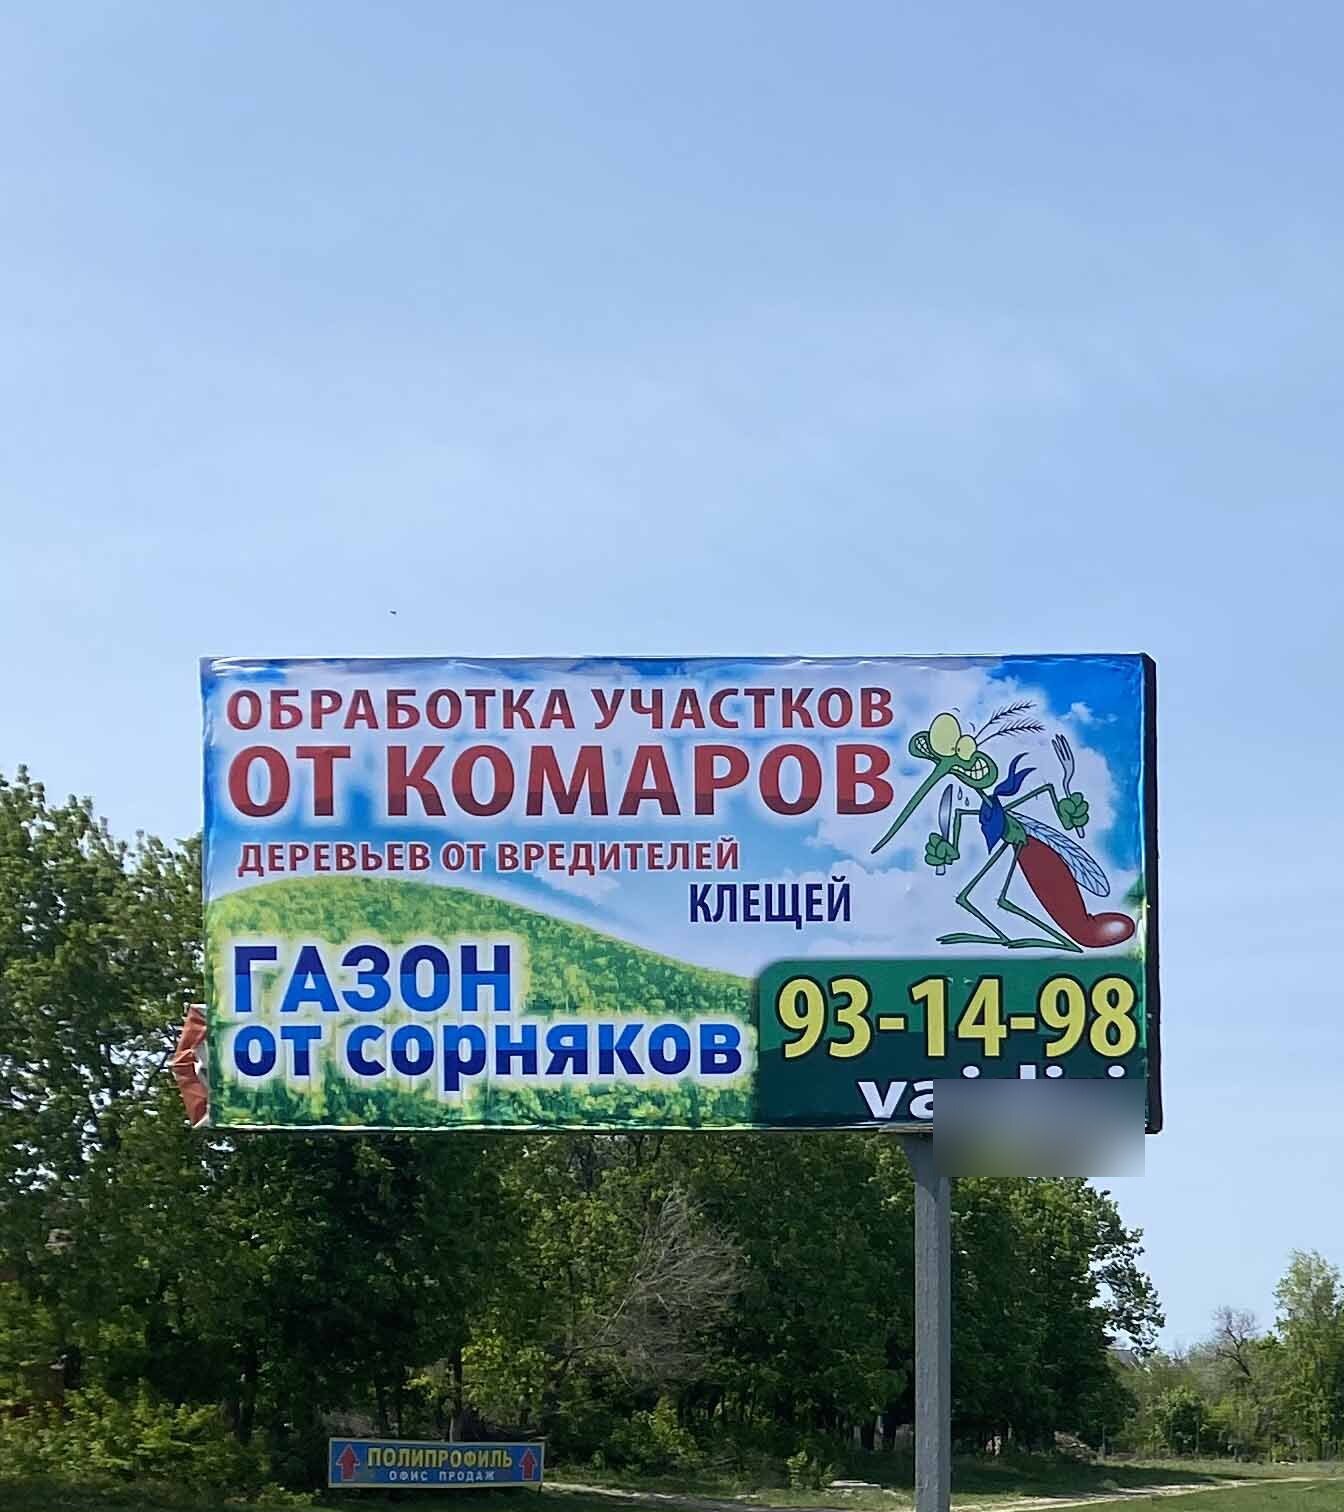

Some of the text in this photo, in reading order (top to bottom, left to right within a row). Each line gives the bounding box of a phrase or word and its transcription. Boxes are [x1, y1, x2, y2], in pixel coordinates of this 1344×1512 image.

[226, 687, 895, 731] ОБРАБОТКА УЧАСТКОВ
[228, 743, 895, 818] ОТ КОМАРОВ
[237, 836, 739, 878] ДЕРЕВЬЕВ ОТ ВРЕДИТЕЛЕЙ
[689, 874, 851, 930] КЛЕЩЕЙ
[233, 945, 512, 1013] ГАЗОН
[777, 976, 1137, 1058] 93-14-98
[233, 1023, 742, 1092] от сорняков
[367, 1447, 513, 1469] ПОЛИПРОФИЛЬ
[389, 1470, 495, 1482] ОФИС ПРОДАЖ
